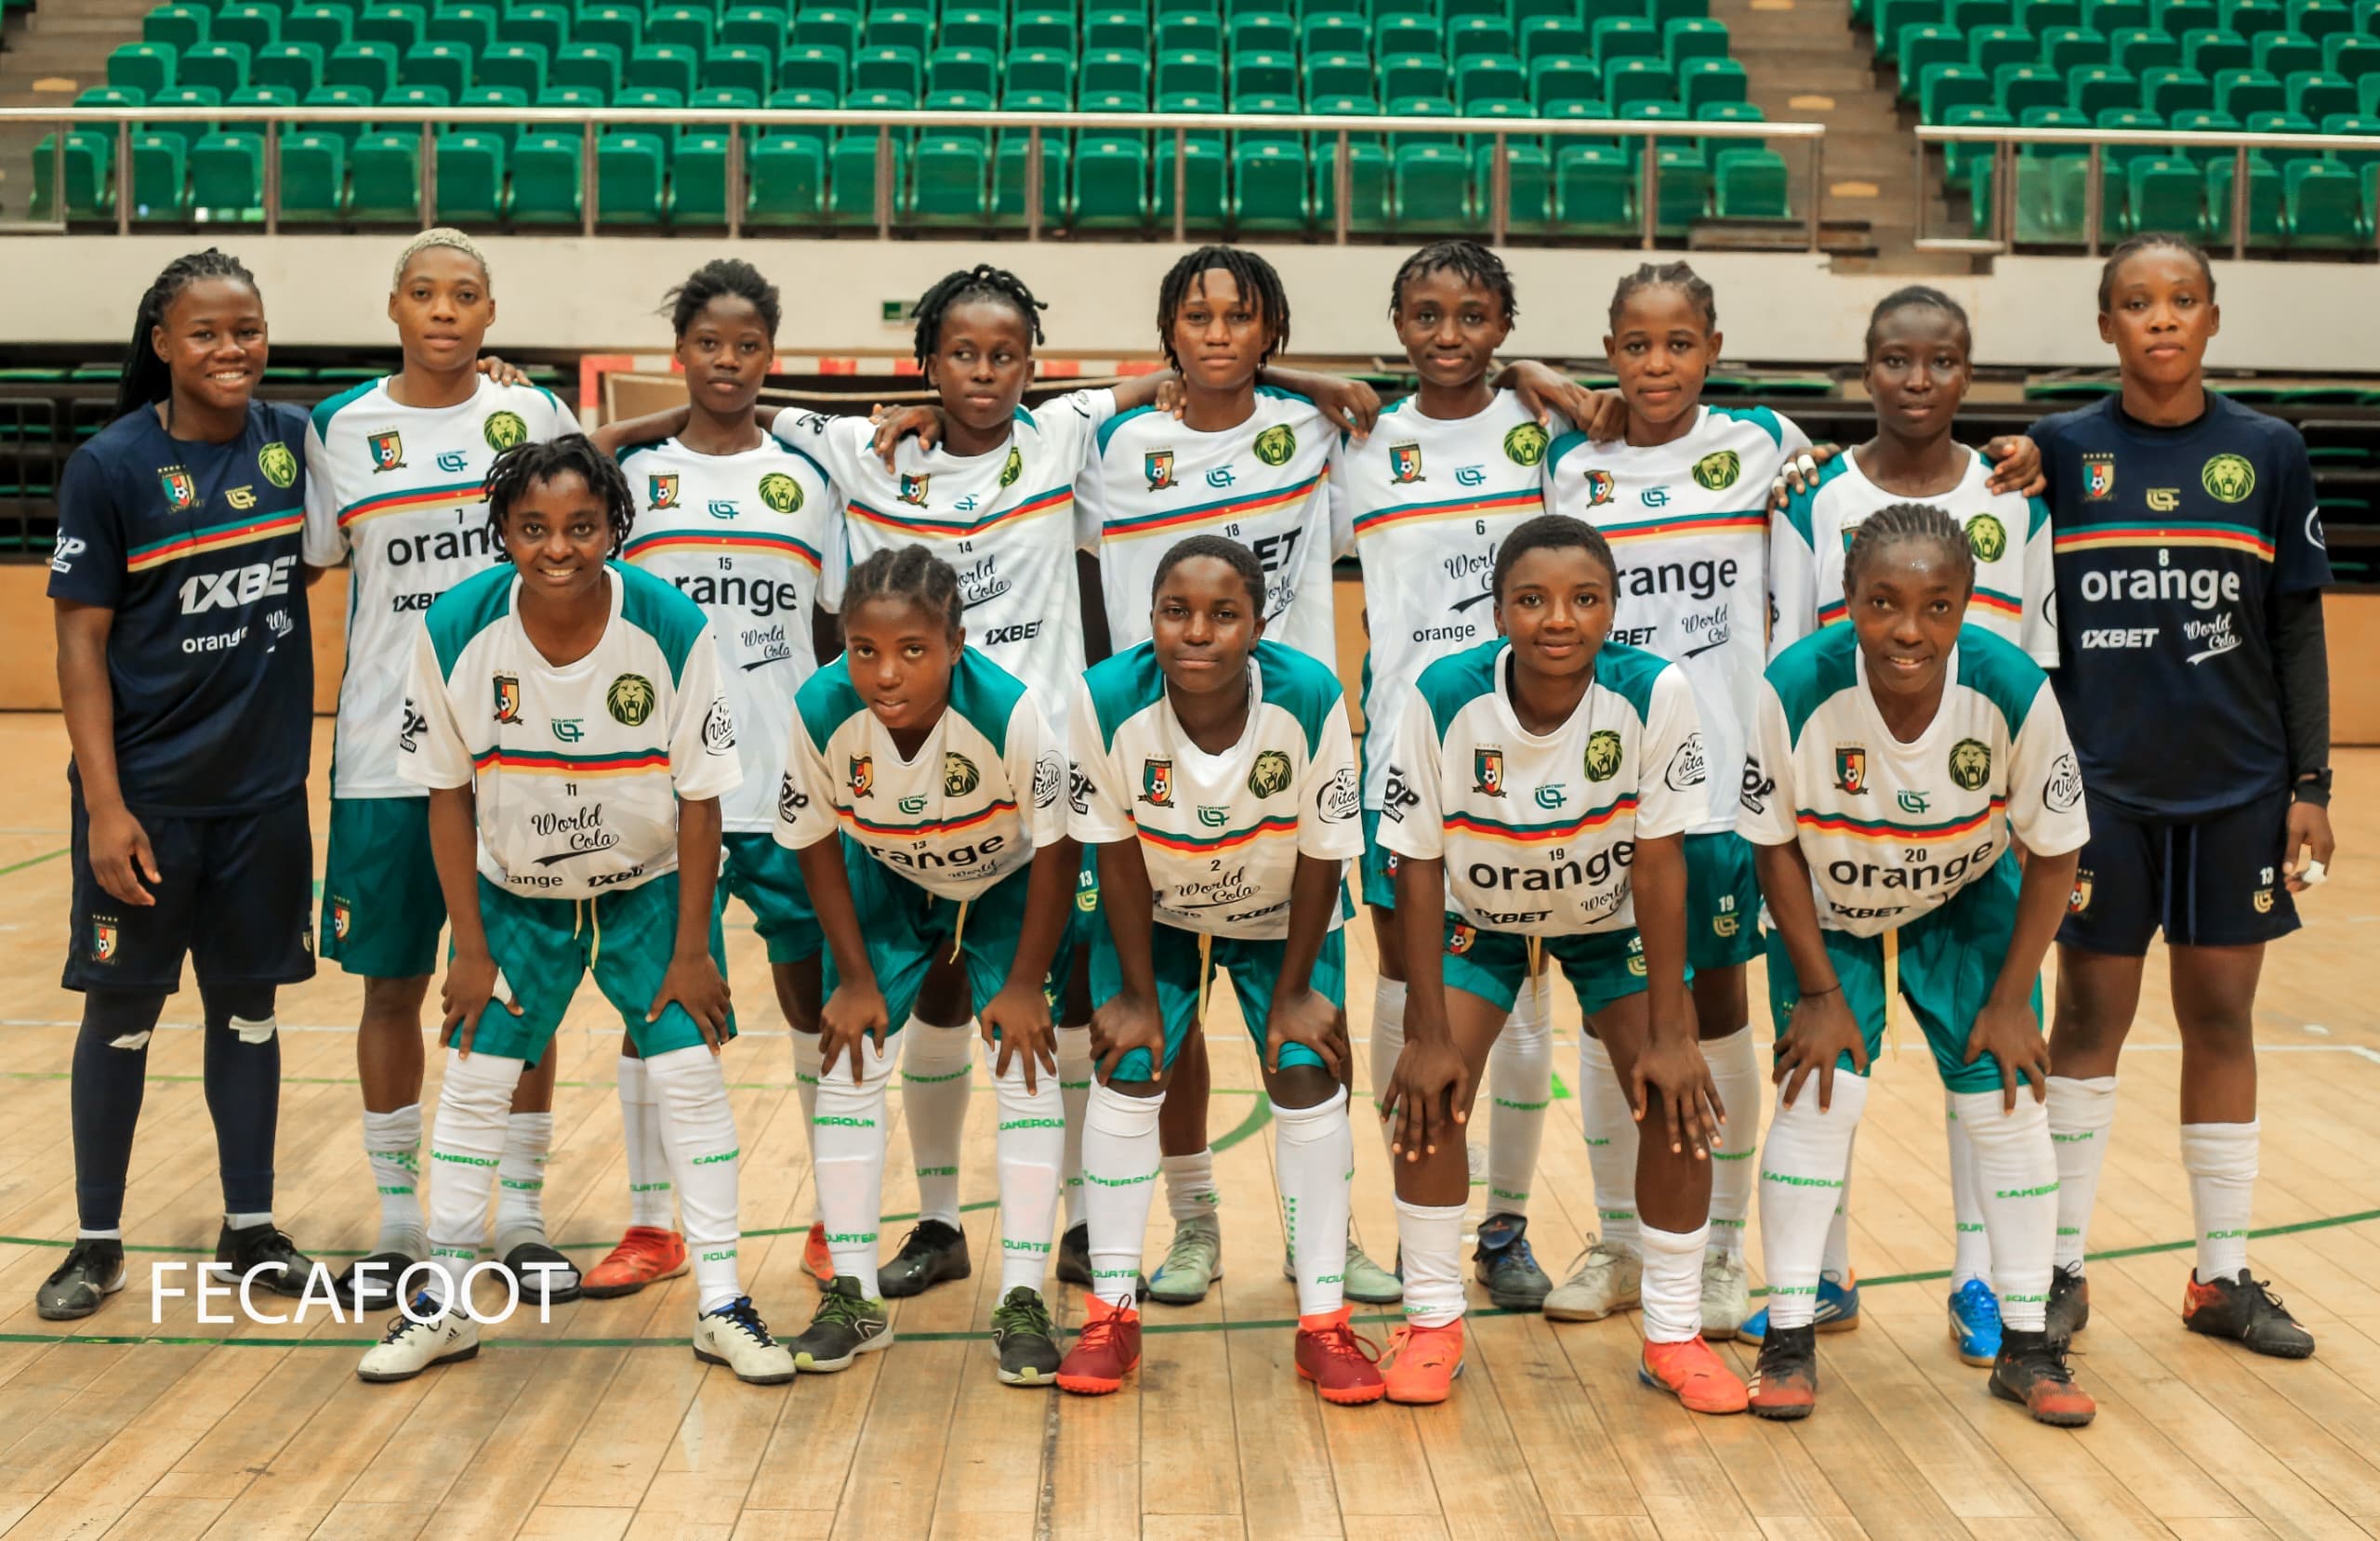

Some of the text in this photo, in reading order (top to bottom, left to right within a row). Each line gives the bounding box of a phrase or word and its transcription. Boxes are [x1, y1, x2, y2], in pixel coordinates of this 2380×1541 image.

[454, 508, 464, 524] 7
[1224, 523, 1240, 537] 18
[1474, 520, 1486, 535] 6
[388, 526, 514, 566] orang
[958, 541, 973, 555] 14
[718, 557, 733, 571] 15
[1444, 543, 1497, 579] Worl
[2158, 548, 2170, 566] 8
[958, 555, 998, 587] orld
[1615, 559, 1738, 599] range
[178, 555, 298, 614] 1XBE
[968, 578, 1012, 602] Cola
[2080, 568, 2241, 611] orange
[392, 591, 450, 612] 1XB
[673, 574, 798, 617] range
[1681, 604, 1728, 634] World
[2183, 612, 2232, 640] World
[740, 625, 787, 648] World
[985, 619, 1043, 645] 1XBET
[1412, 623, 1475, 642] orange
[1606, 626, 1658, 645] BET
[2081, 627, 2161, 649] 1XBET
[2208, 632, 2243, 652] Cola
[763, 642, 793, 658] Cola
[564, 783, 577, 797] 11
[531, 803, 603, 836] World
[569, 831, 620, 851] Cola
[910, 839, 927, 851] 13
[863, 834, 1004, 871] range
[1548, 848, 1566, 862] 19
[1904, 848, 1927, 863] 20
[1210, 859, 1222, 872] 2
[1468, 840, 1634, 892] orange
[1828, 840, 1994, 890] orange
[1078, 870, 1093, 887] 13
[1175, 866, 1246, 897] World
[2260, 866, 2275, 885] 13
[1211, 883, 1261, 904] Cola
[1718, 895, 1735, 912] 19
[1225, 899, 1290, 923] 1XBE
[1474, 907, 1554, 924] 1XBET
[1829, 902, 1911, 919] 1XBET
